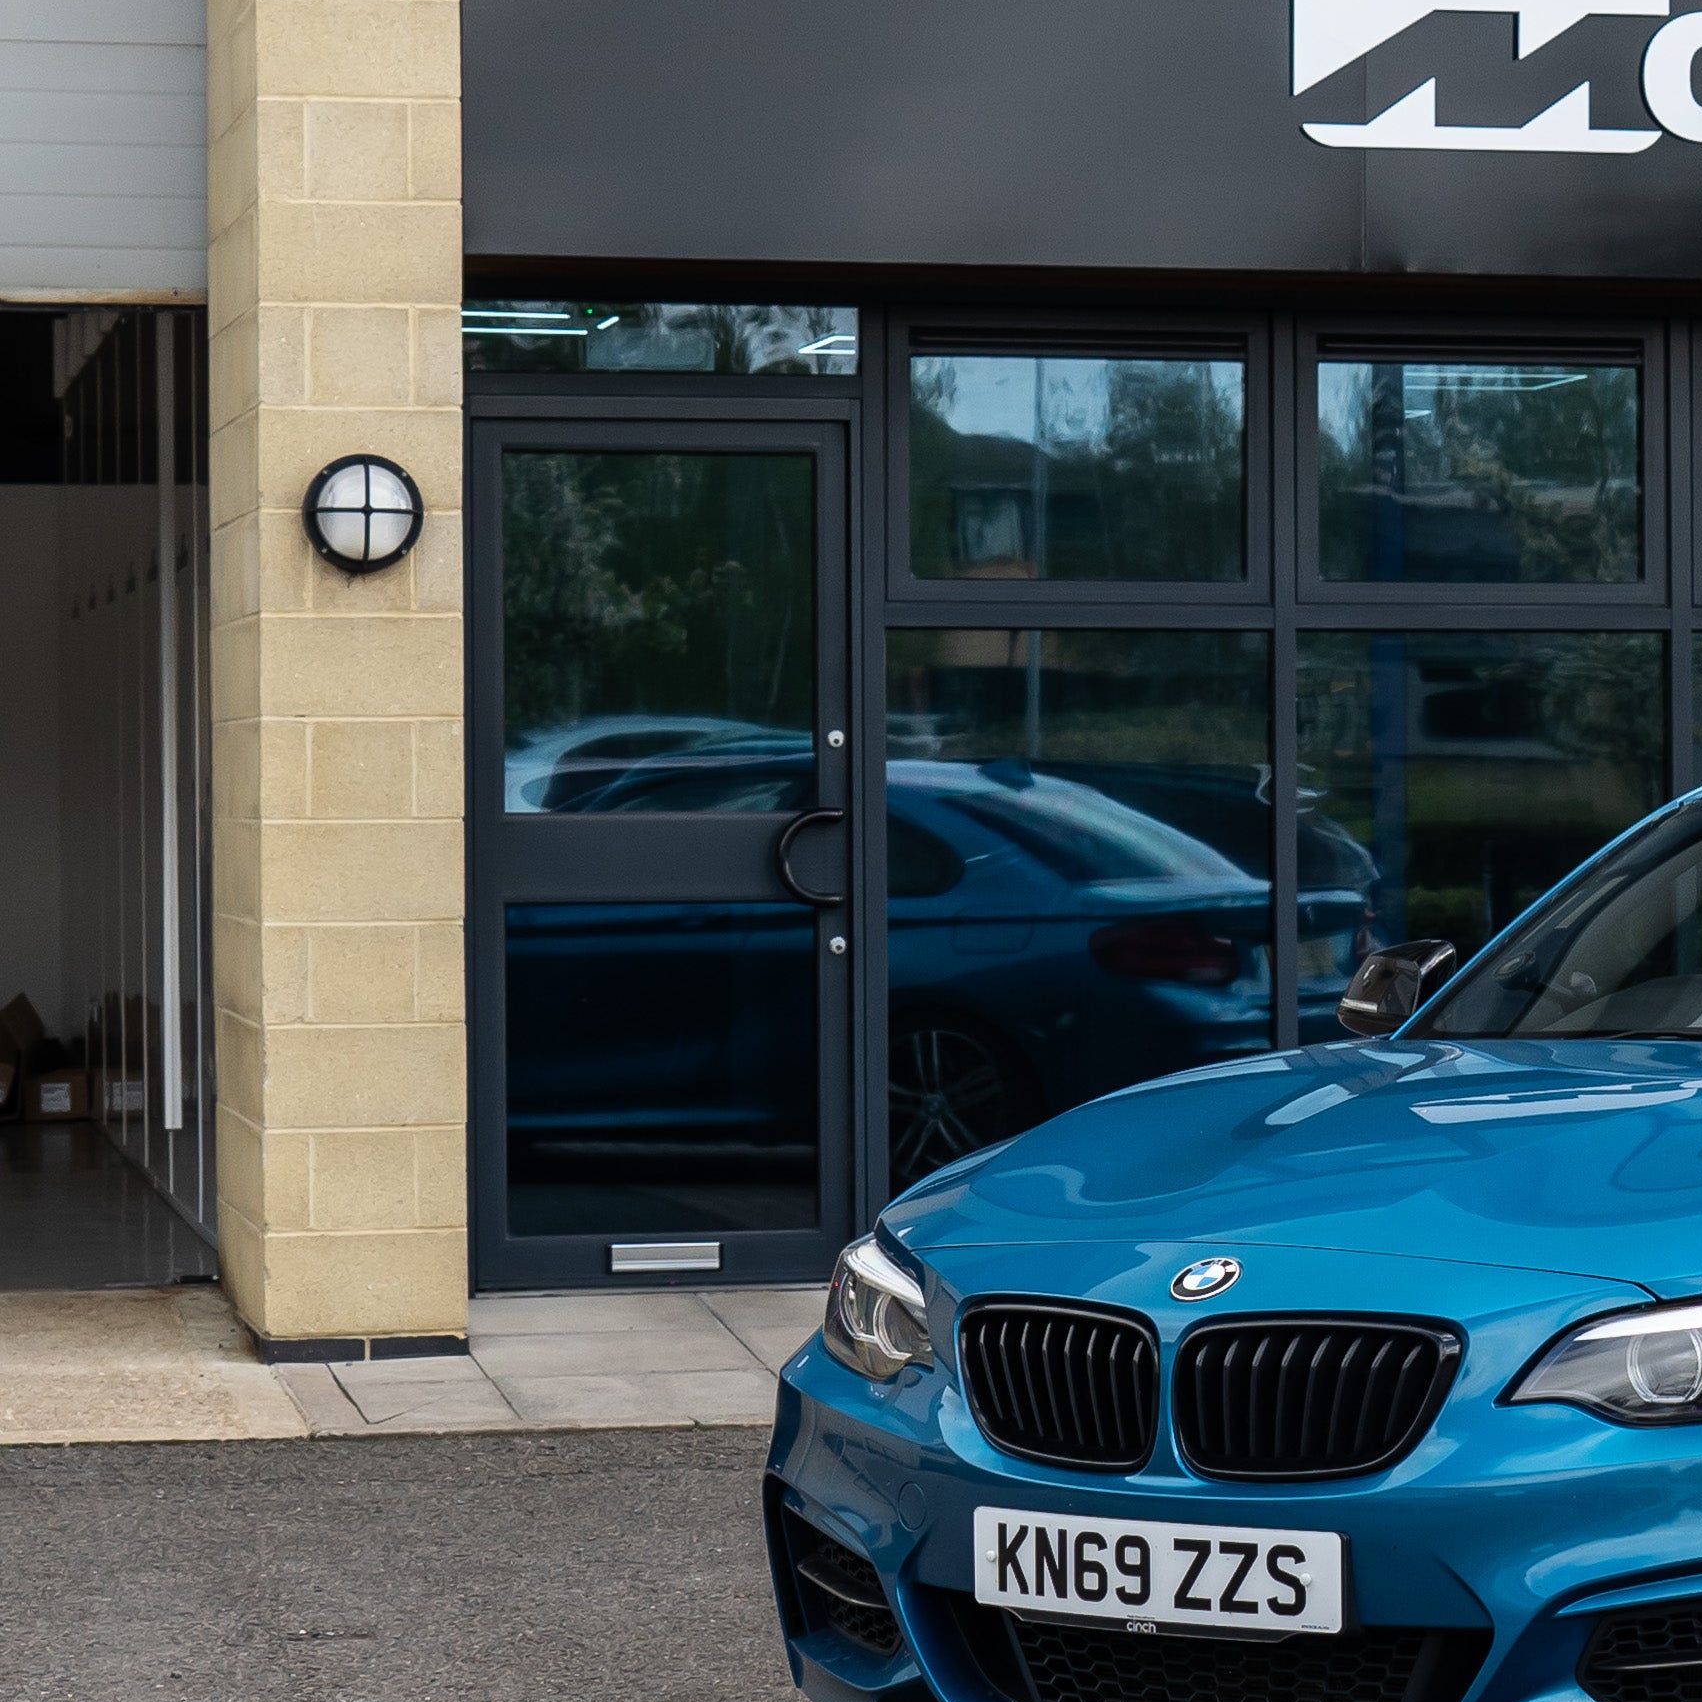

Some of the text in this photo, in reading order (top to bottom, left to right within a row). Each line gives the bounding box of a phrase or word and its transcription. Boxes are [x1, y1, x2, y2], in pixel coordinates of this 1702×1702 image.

[997, 1521, 1307, 1617] KN69 ZZS
[1126, 1619, 1157, 1634] cinch
